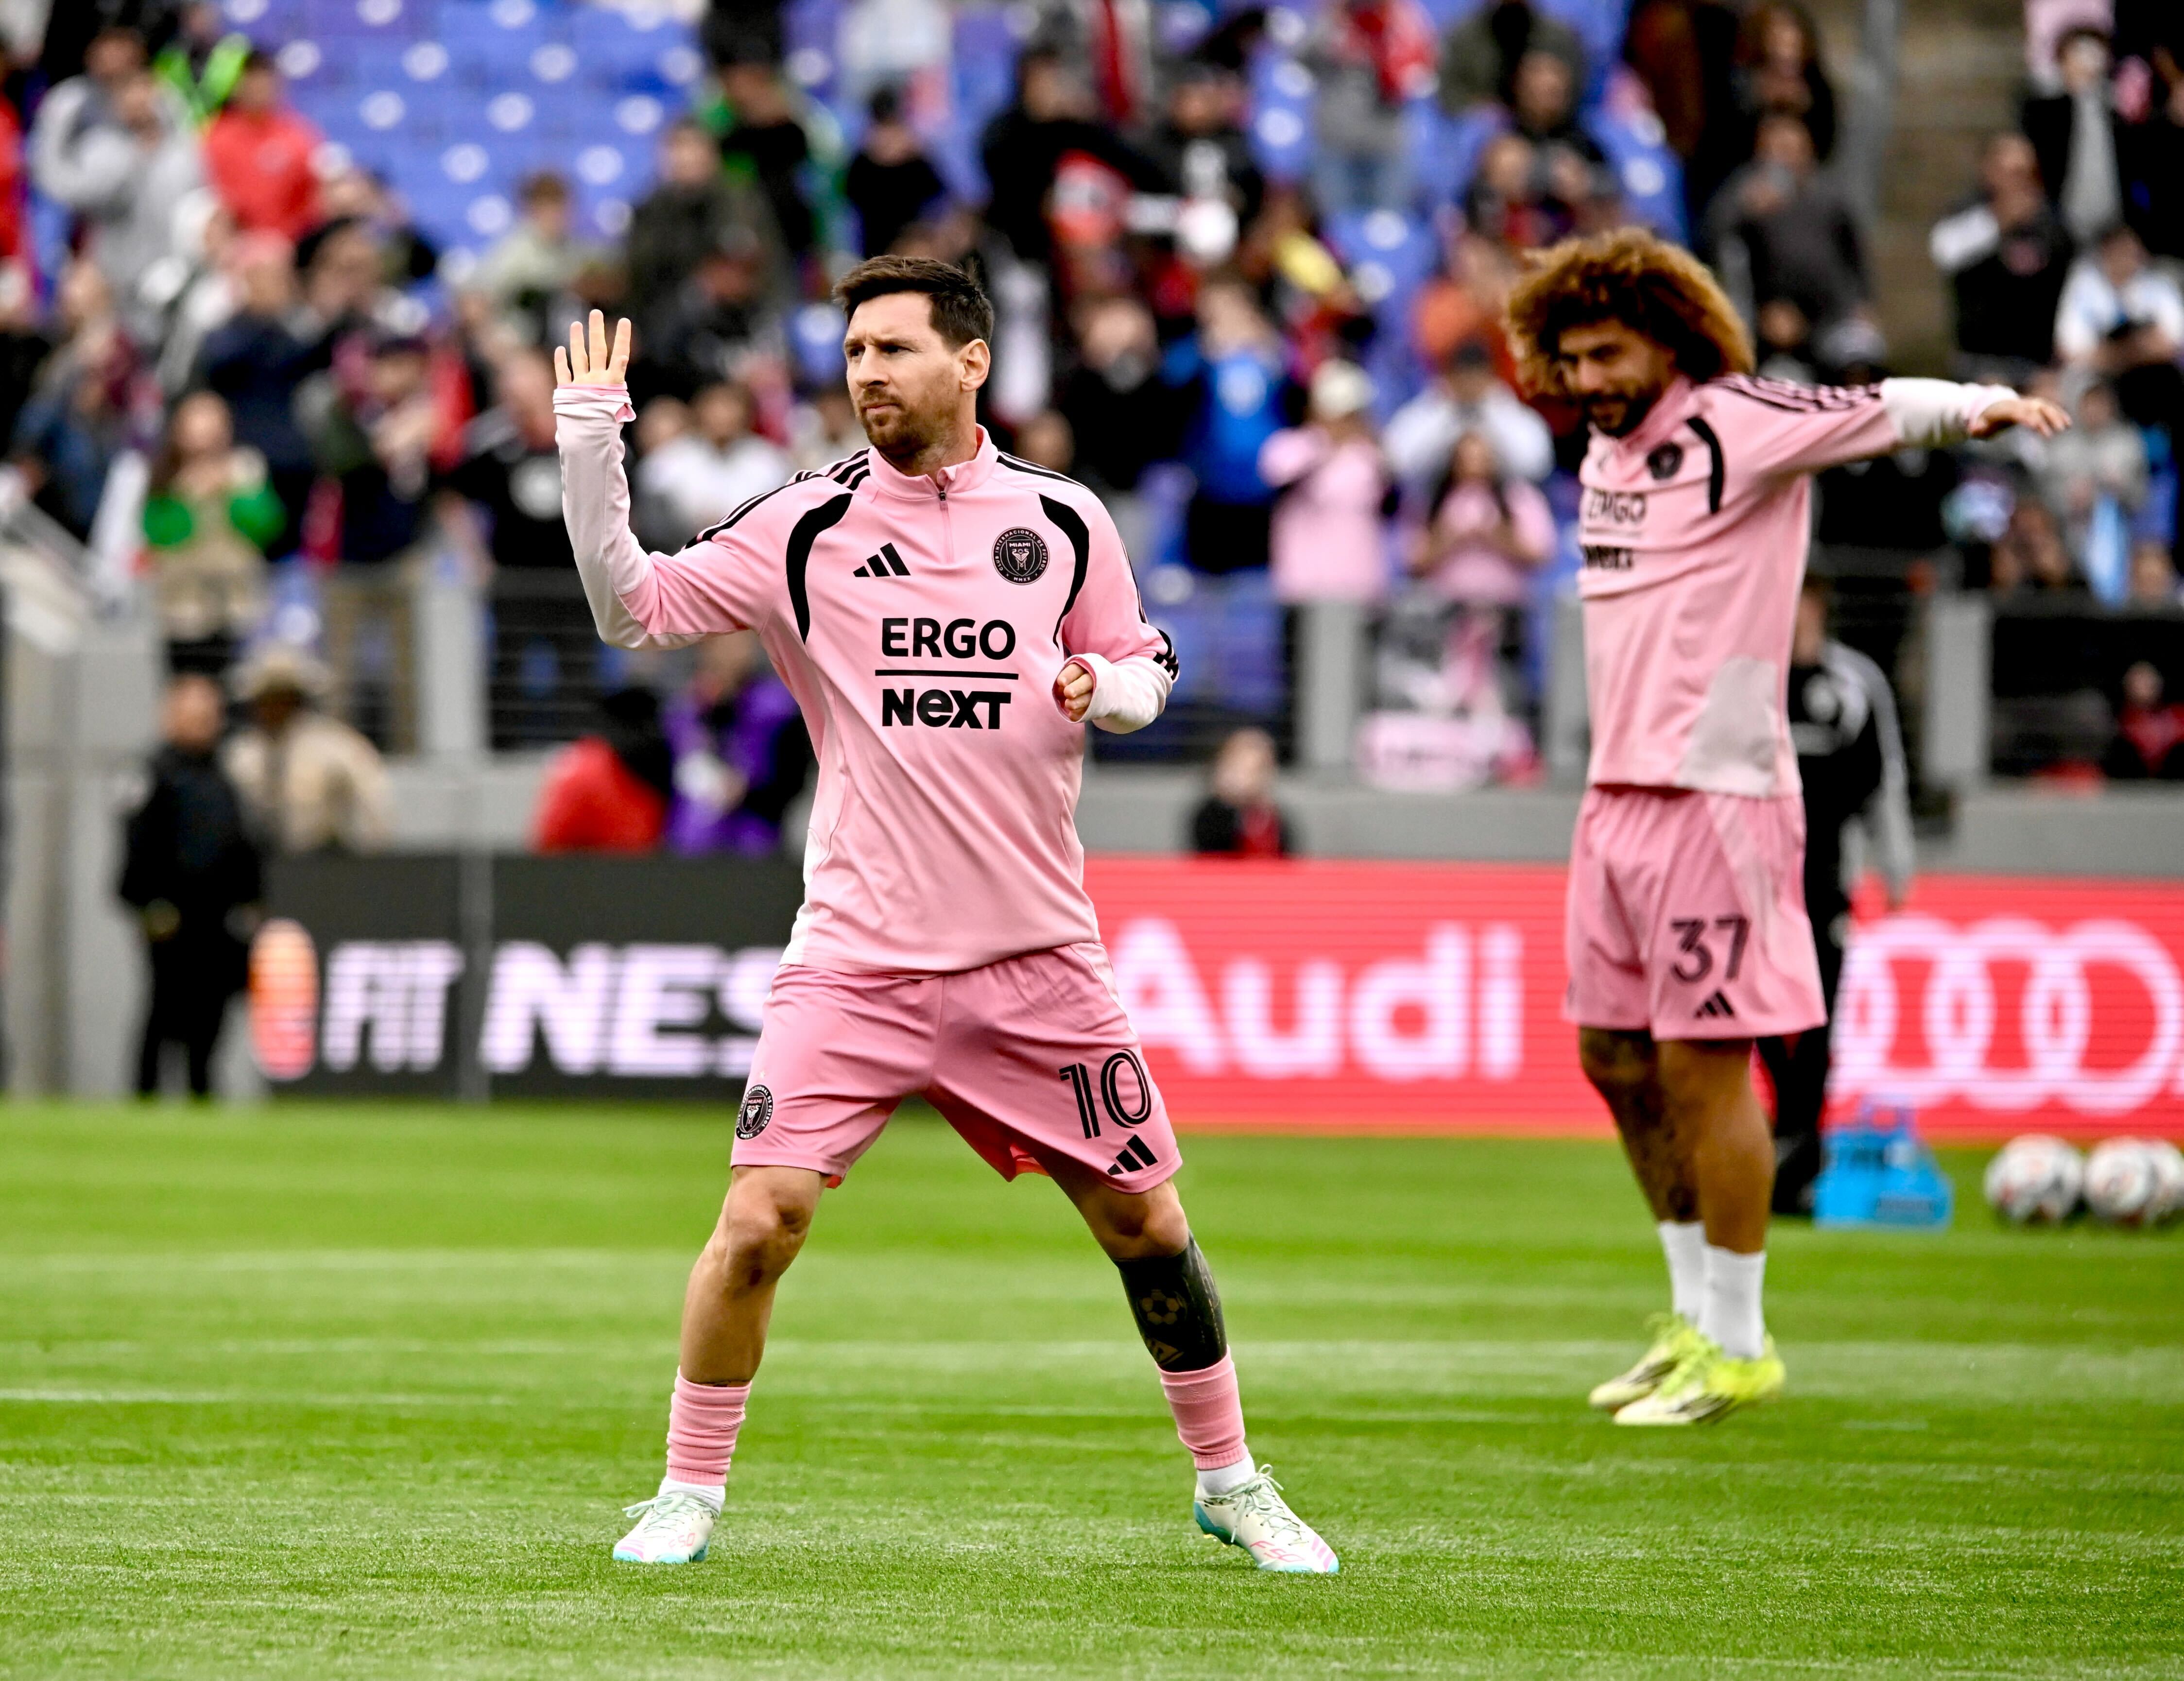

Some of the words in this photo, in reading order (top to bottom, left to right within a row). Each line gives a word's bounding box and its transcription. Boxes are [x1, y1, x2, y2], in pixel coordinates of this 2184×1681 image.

[995, 530, 1036, 553] INTERNACIONAL
[995, 556, 1003, 571] CLUB
[881, 618, 1015, 660] ERGO
[1670, 915, 1750, 983] 37
[1112, 916, 1525, 1081] Audi
[1059, 1048, 1151, 1139] 10
[1249, 1541, 1306, 1562] F50
